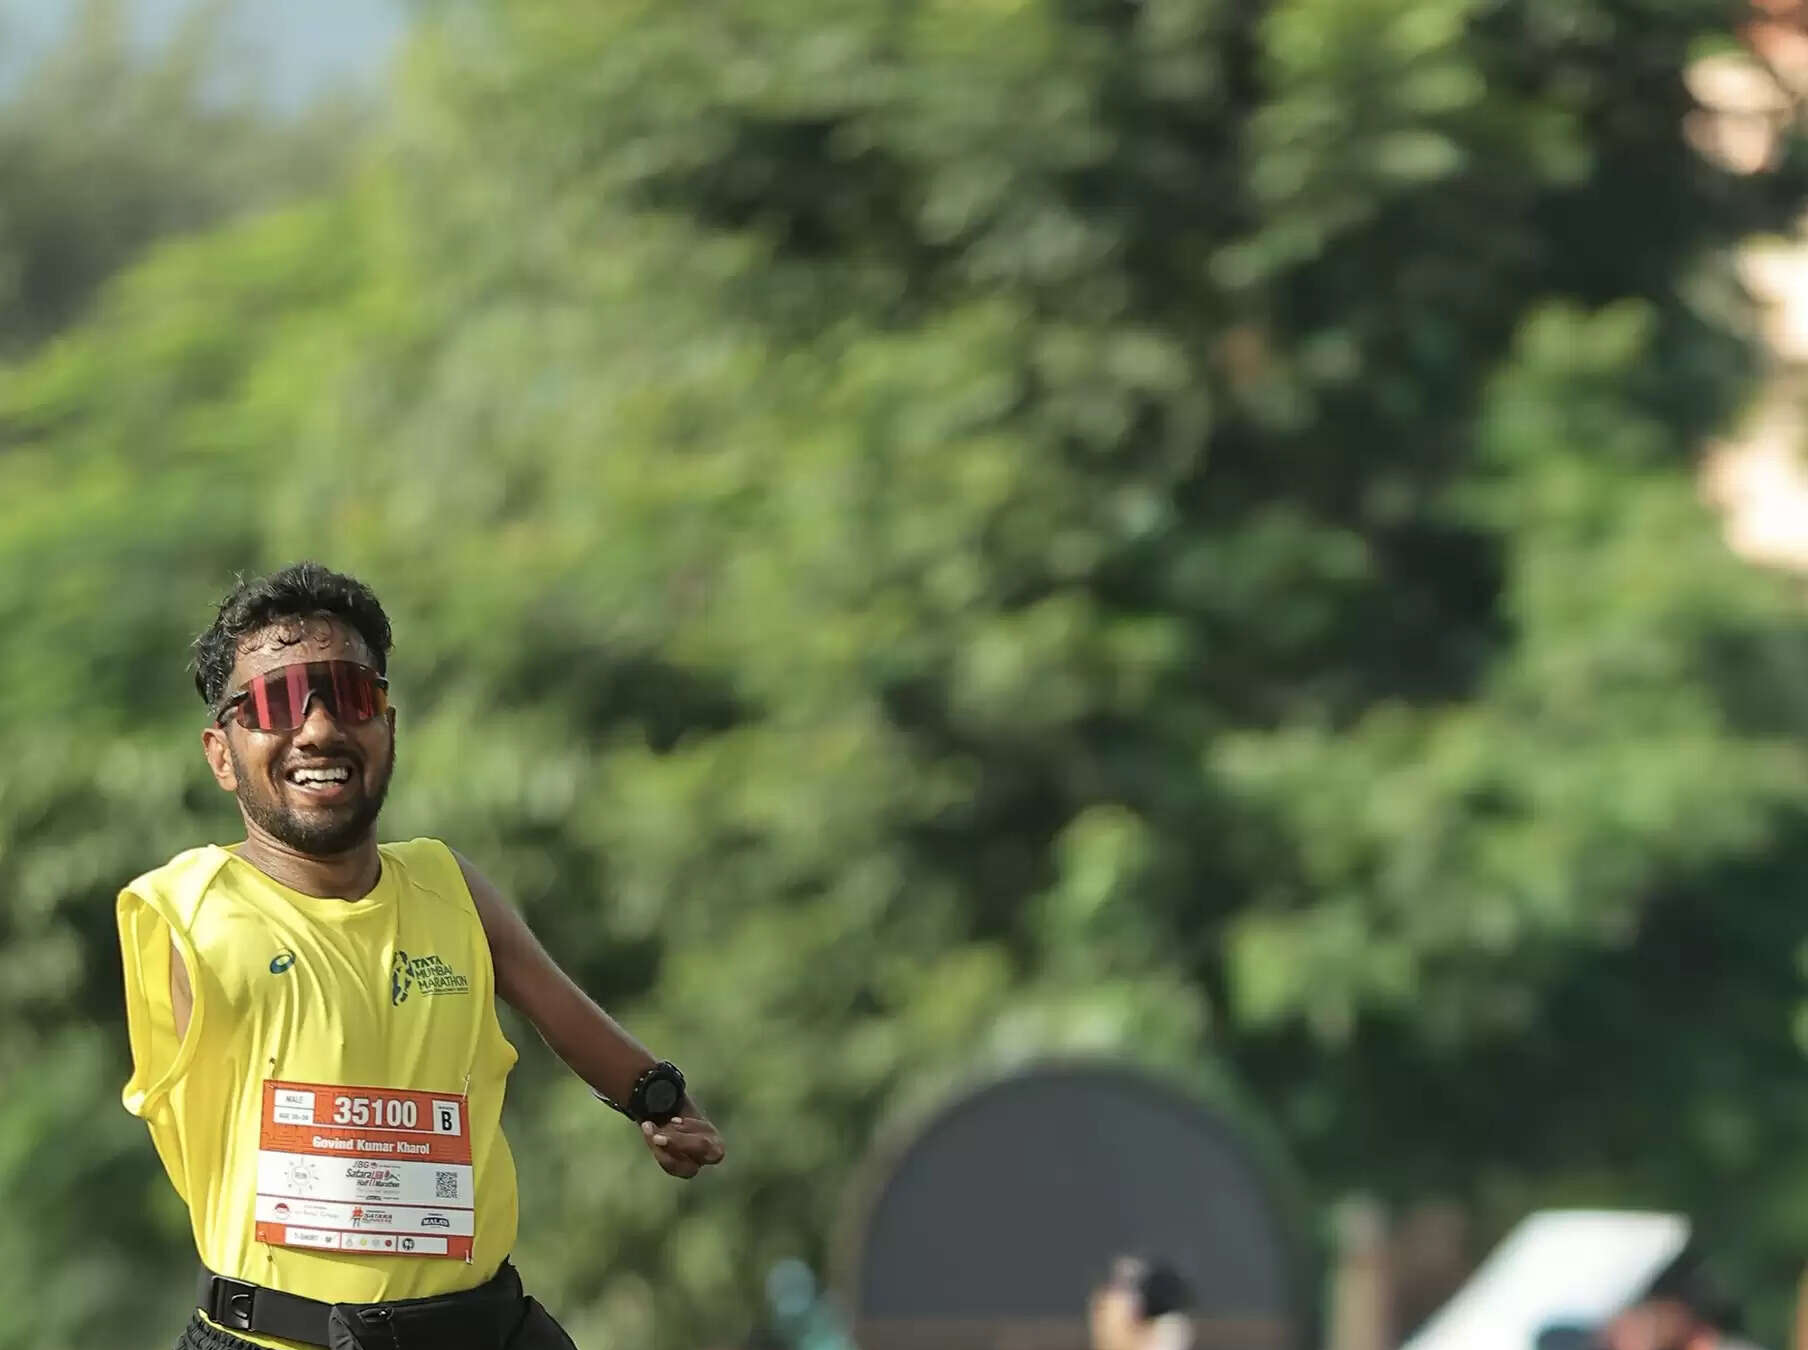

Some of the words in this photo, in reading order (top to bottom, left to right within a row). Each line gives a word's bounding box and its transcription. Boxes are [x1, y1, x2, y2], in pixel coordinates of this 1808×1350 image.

[412, 955, 443, 969] TATA
[414, 964, 453, 979] MUMBAI
[417, 975, 468, 990] MARATHON
[333, 1096, 417, 1128] 35100
[441, 1110, 453, 1131] B
[312, 1135, 354, 1150] Govind
[356, 1139, 395, 1153] Kumar
[396, 1141, 430, 1154] Kharol
[345, 1168, 372, 1178] Satara
